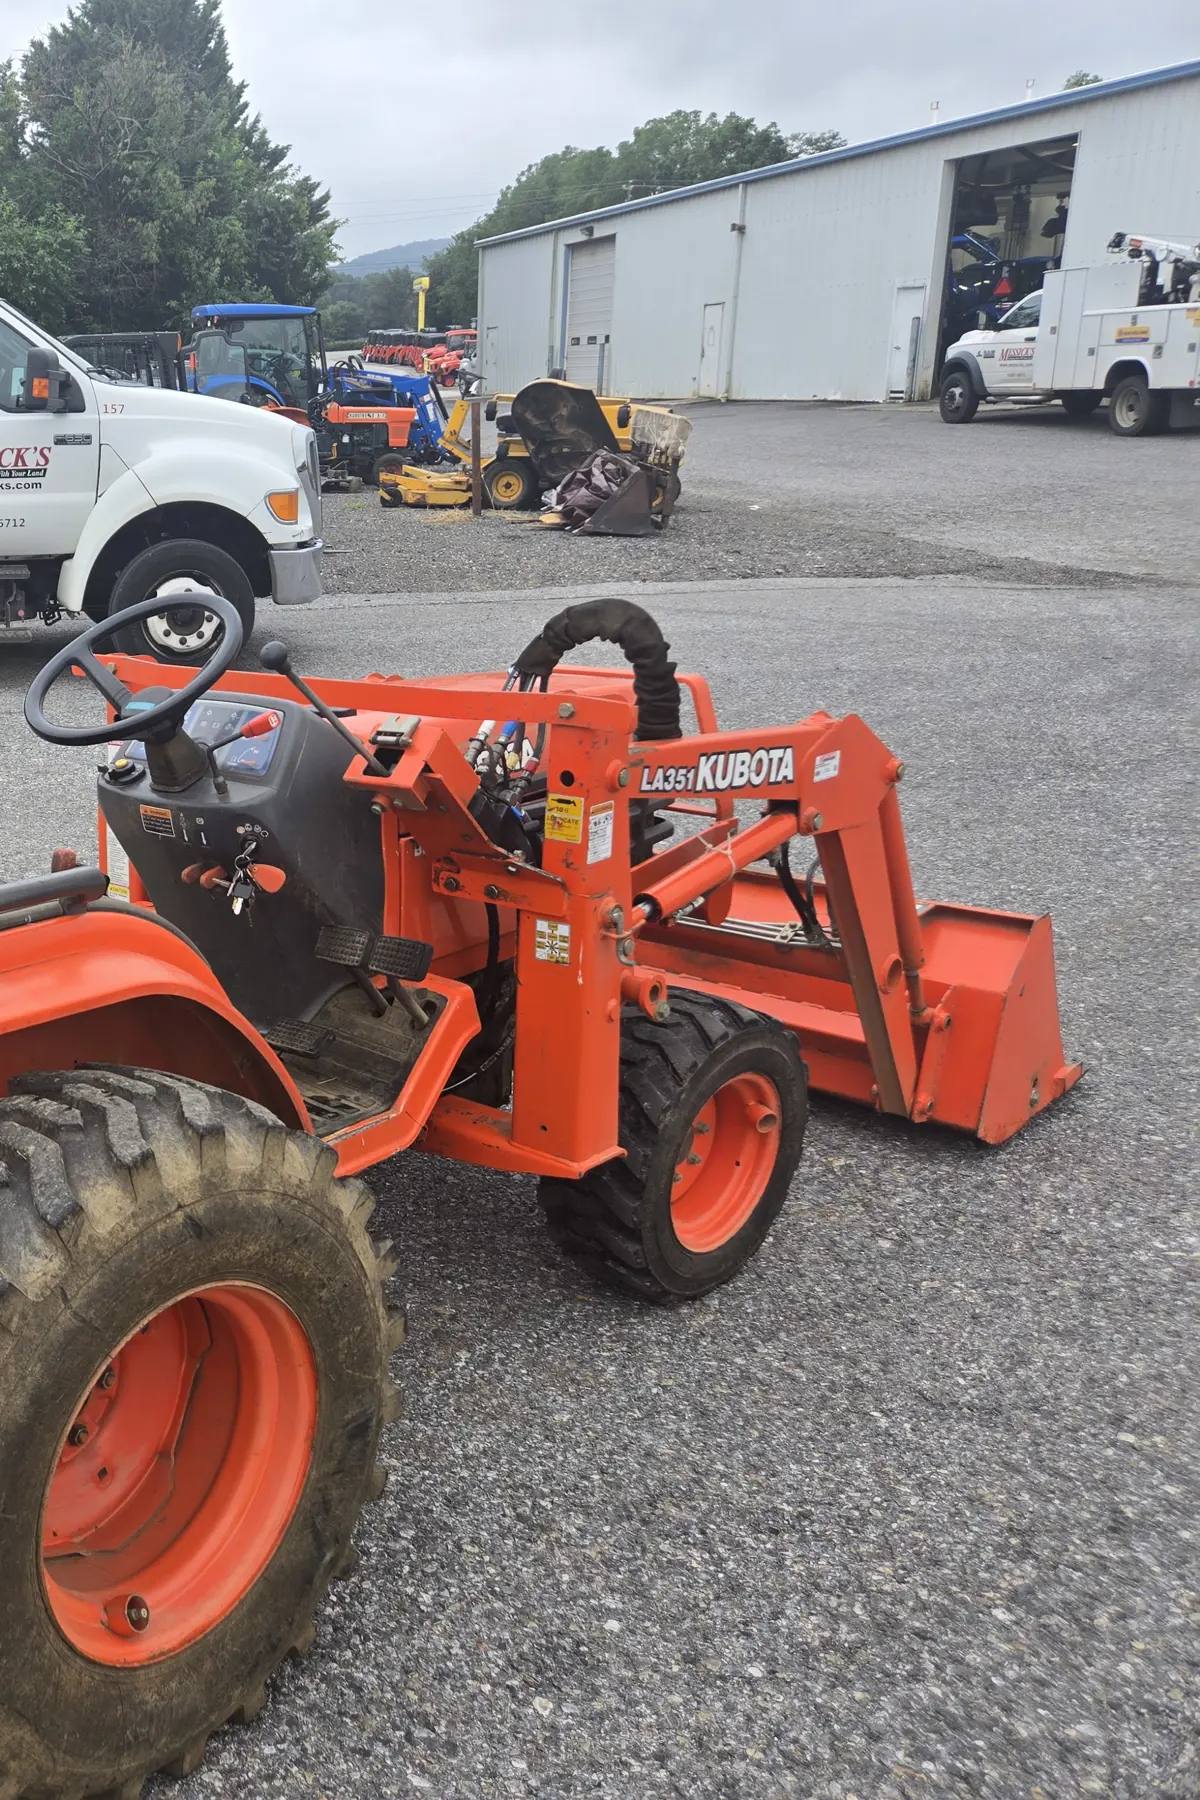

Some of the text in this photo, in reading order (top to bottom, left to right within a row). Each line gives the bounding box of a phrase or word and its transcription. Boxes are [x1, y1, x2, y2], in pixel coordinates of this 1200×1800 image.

[103, 404, 125, 414] 157
[11, 469, 26, 477] Your
[27, 469, 44, 477] Land
[640, 766, 696, 792] LA351
[695, 747, 794, 791] KUBOTA
